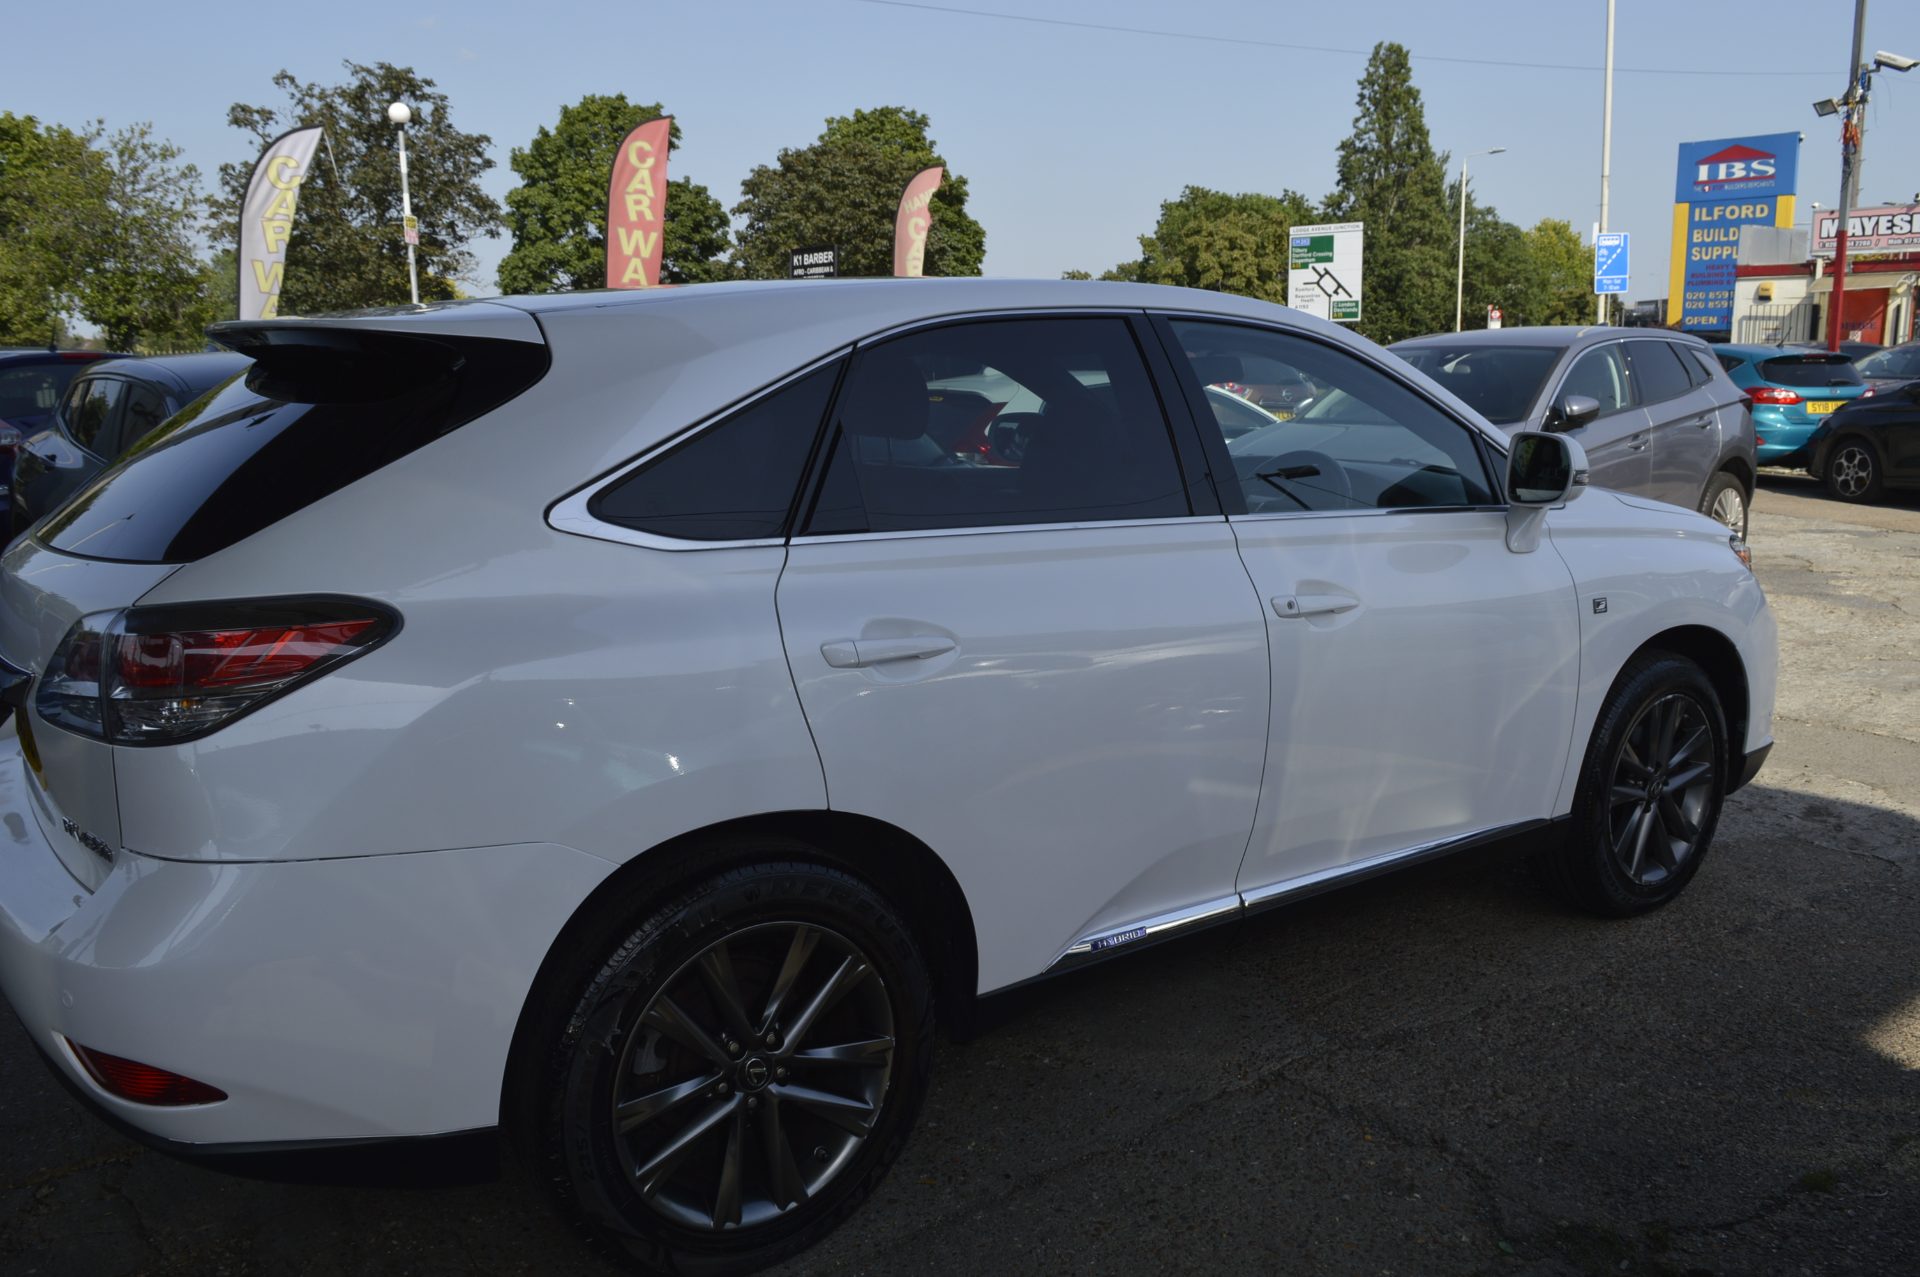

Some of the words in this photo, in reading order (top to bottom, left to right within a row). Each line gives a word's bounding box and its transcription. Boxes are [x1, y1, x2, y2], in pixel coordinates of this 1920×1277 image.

[1698, 158, 1776, 181] IBS
[625, 140, 656, 222] CAR
[1694, 203, 1769, 221] ILFORD
[793, 254, 803, 266] K1
[803, 251, 834, 265] BARBER
[1686, 291, 1705, 299] 020
[1685, 300, 1705, 308] 020
[1685, 316, 1717, 325] OPEN
[1811, 402, 1830, 412] SY18
